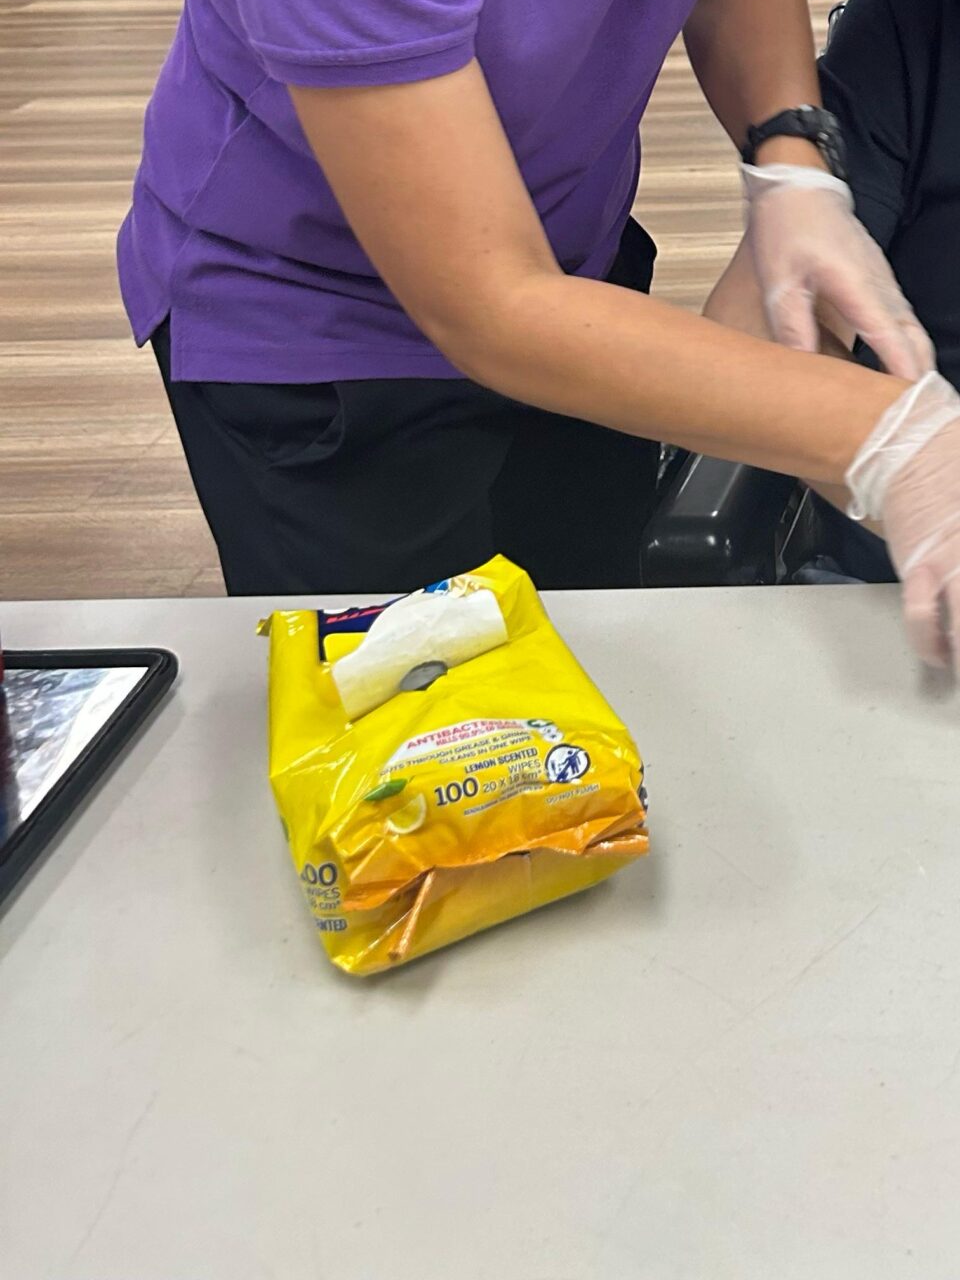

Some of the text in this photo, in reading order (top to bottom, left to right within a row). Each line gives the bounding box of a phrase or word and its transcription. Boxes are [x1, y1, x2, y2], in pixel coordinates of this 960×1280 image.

[407, 720, 519, 750] ANTIBACTERIAL
[407, 750, 454, 767] THROUGH
[454, 739, 490, 754] GREASE
[439, 751, 476, 765] CLEANS
[477, 747, 488, 755] IN
[488, 742, 508, 752] ONE
[464, 748, 538, 775] LEMON SCENTED
[508, 759, 542, 774] WIPES
[434, 776, 479, 807] 100
[483, 781, 497, 793] 20
[509, 773, 520, 784] 18
[301, 862, 338, 887] 00
[317, 918, 348, 932] NTED
